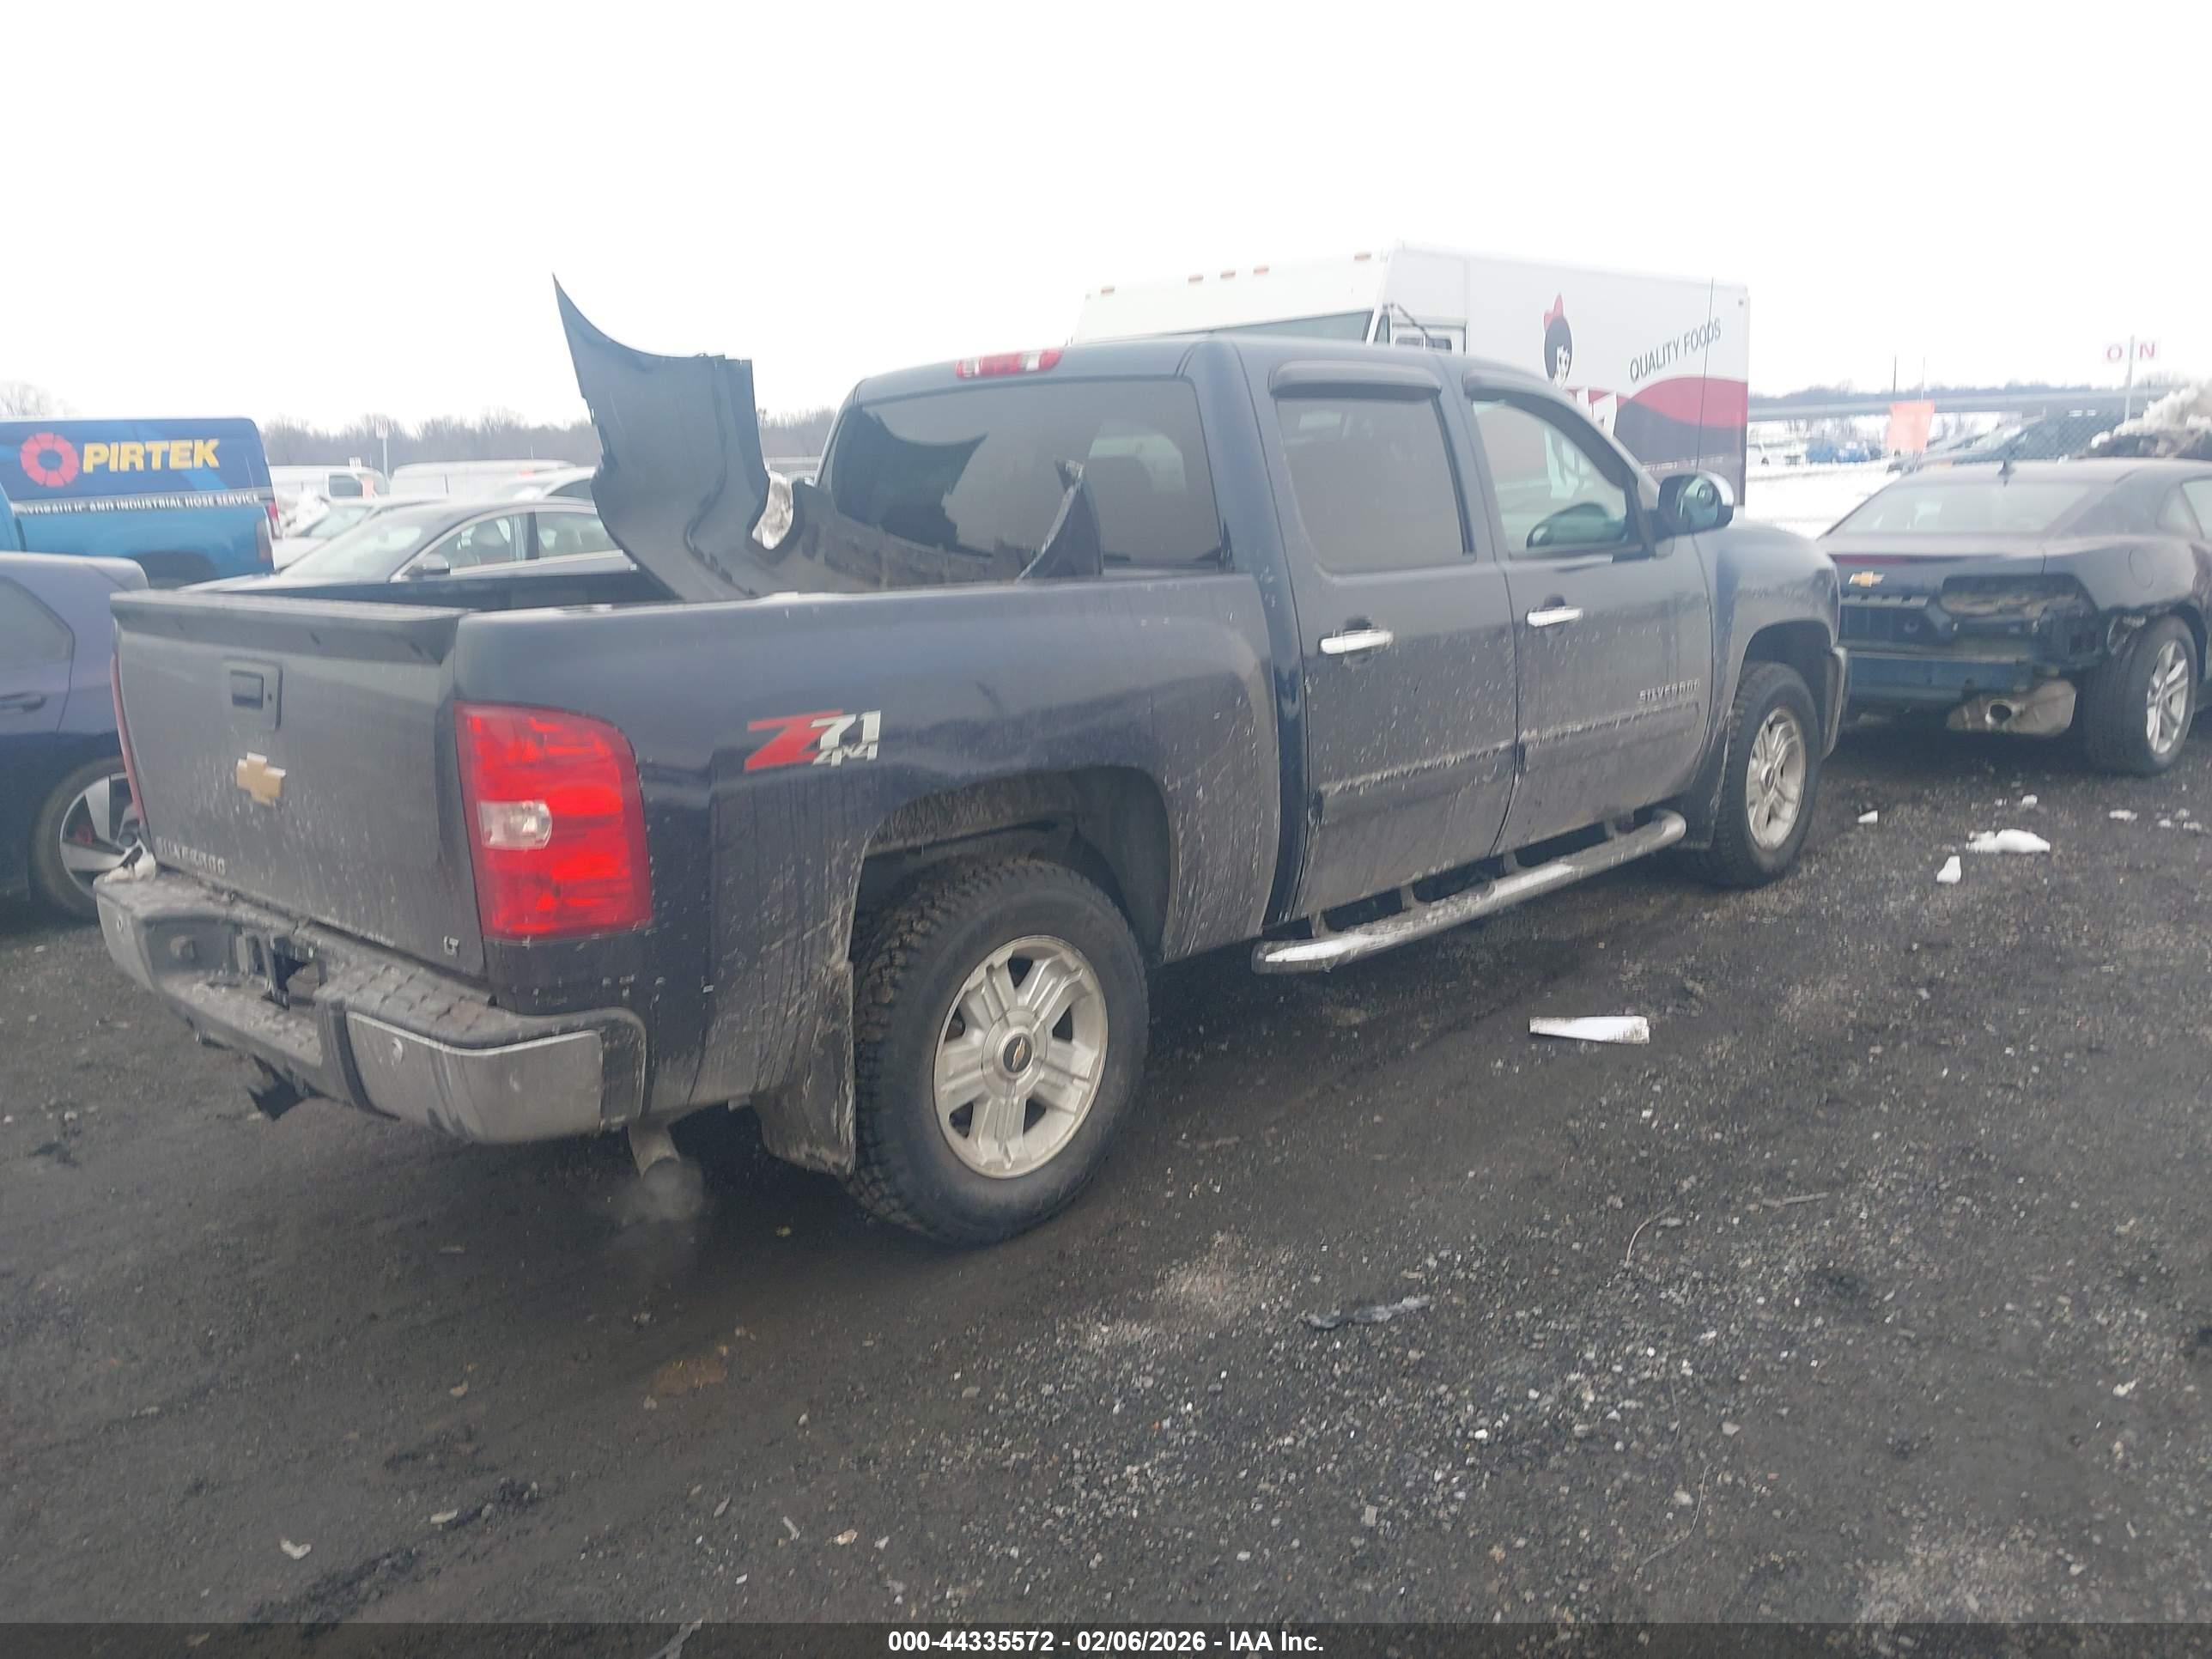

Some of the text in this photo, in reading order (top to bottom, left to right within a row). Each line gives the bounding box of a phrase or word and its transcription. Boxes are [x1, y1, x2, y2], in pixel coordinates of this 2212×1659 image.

[1629, 318, 1722, 383] QUALITY FOODS
[2139, 343, 2155, 359] N
[82, 439, 220, 473] PIRTEK
[744, 709, 881, 773] Z71
